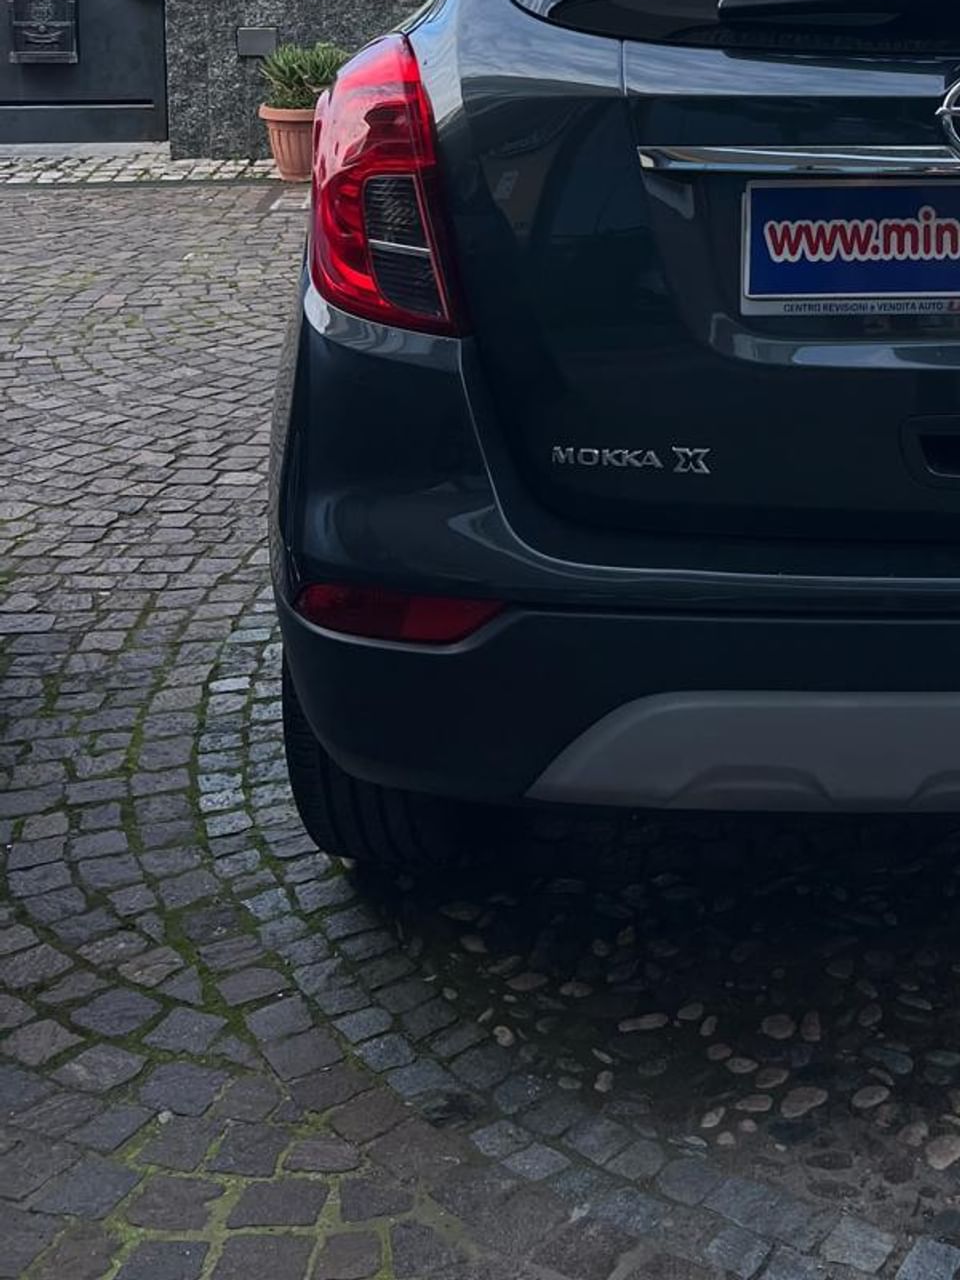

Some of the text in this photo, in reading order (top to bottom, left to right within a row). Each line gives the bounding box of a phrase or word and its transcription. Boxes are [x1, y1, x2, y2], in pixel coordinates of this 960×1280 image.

[783, 303, 821, 313] CENTRO
[822, 302, 869, 312] REVISIONI
[876, 302, 917, 312] VENDITA
[918, 301, 944, 311] AUTO
[551, 445, 711, 474] MOKKA X
